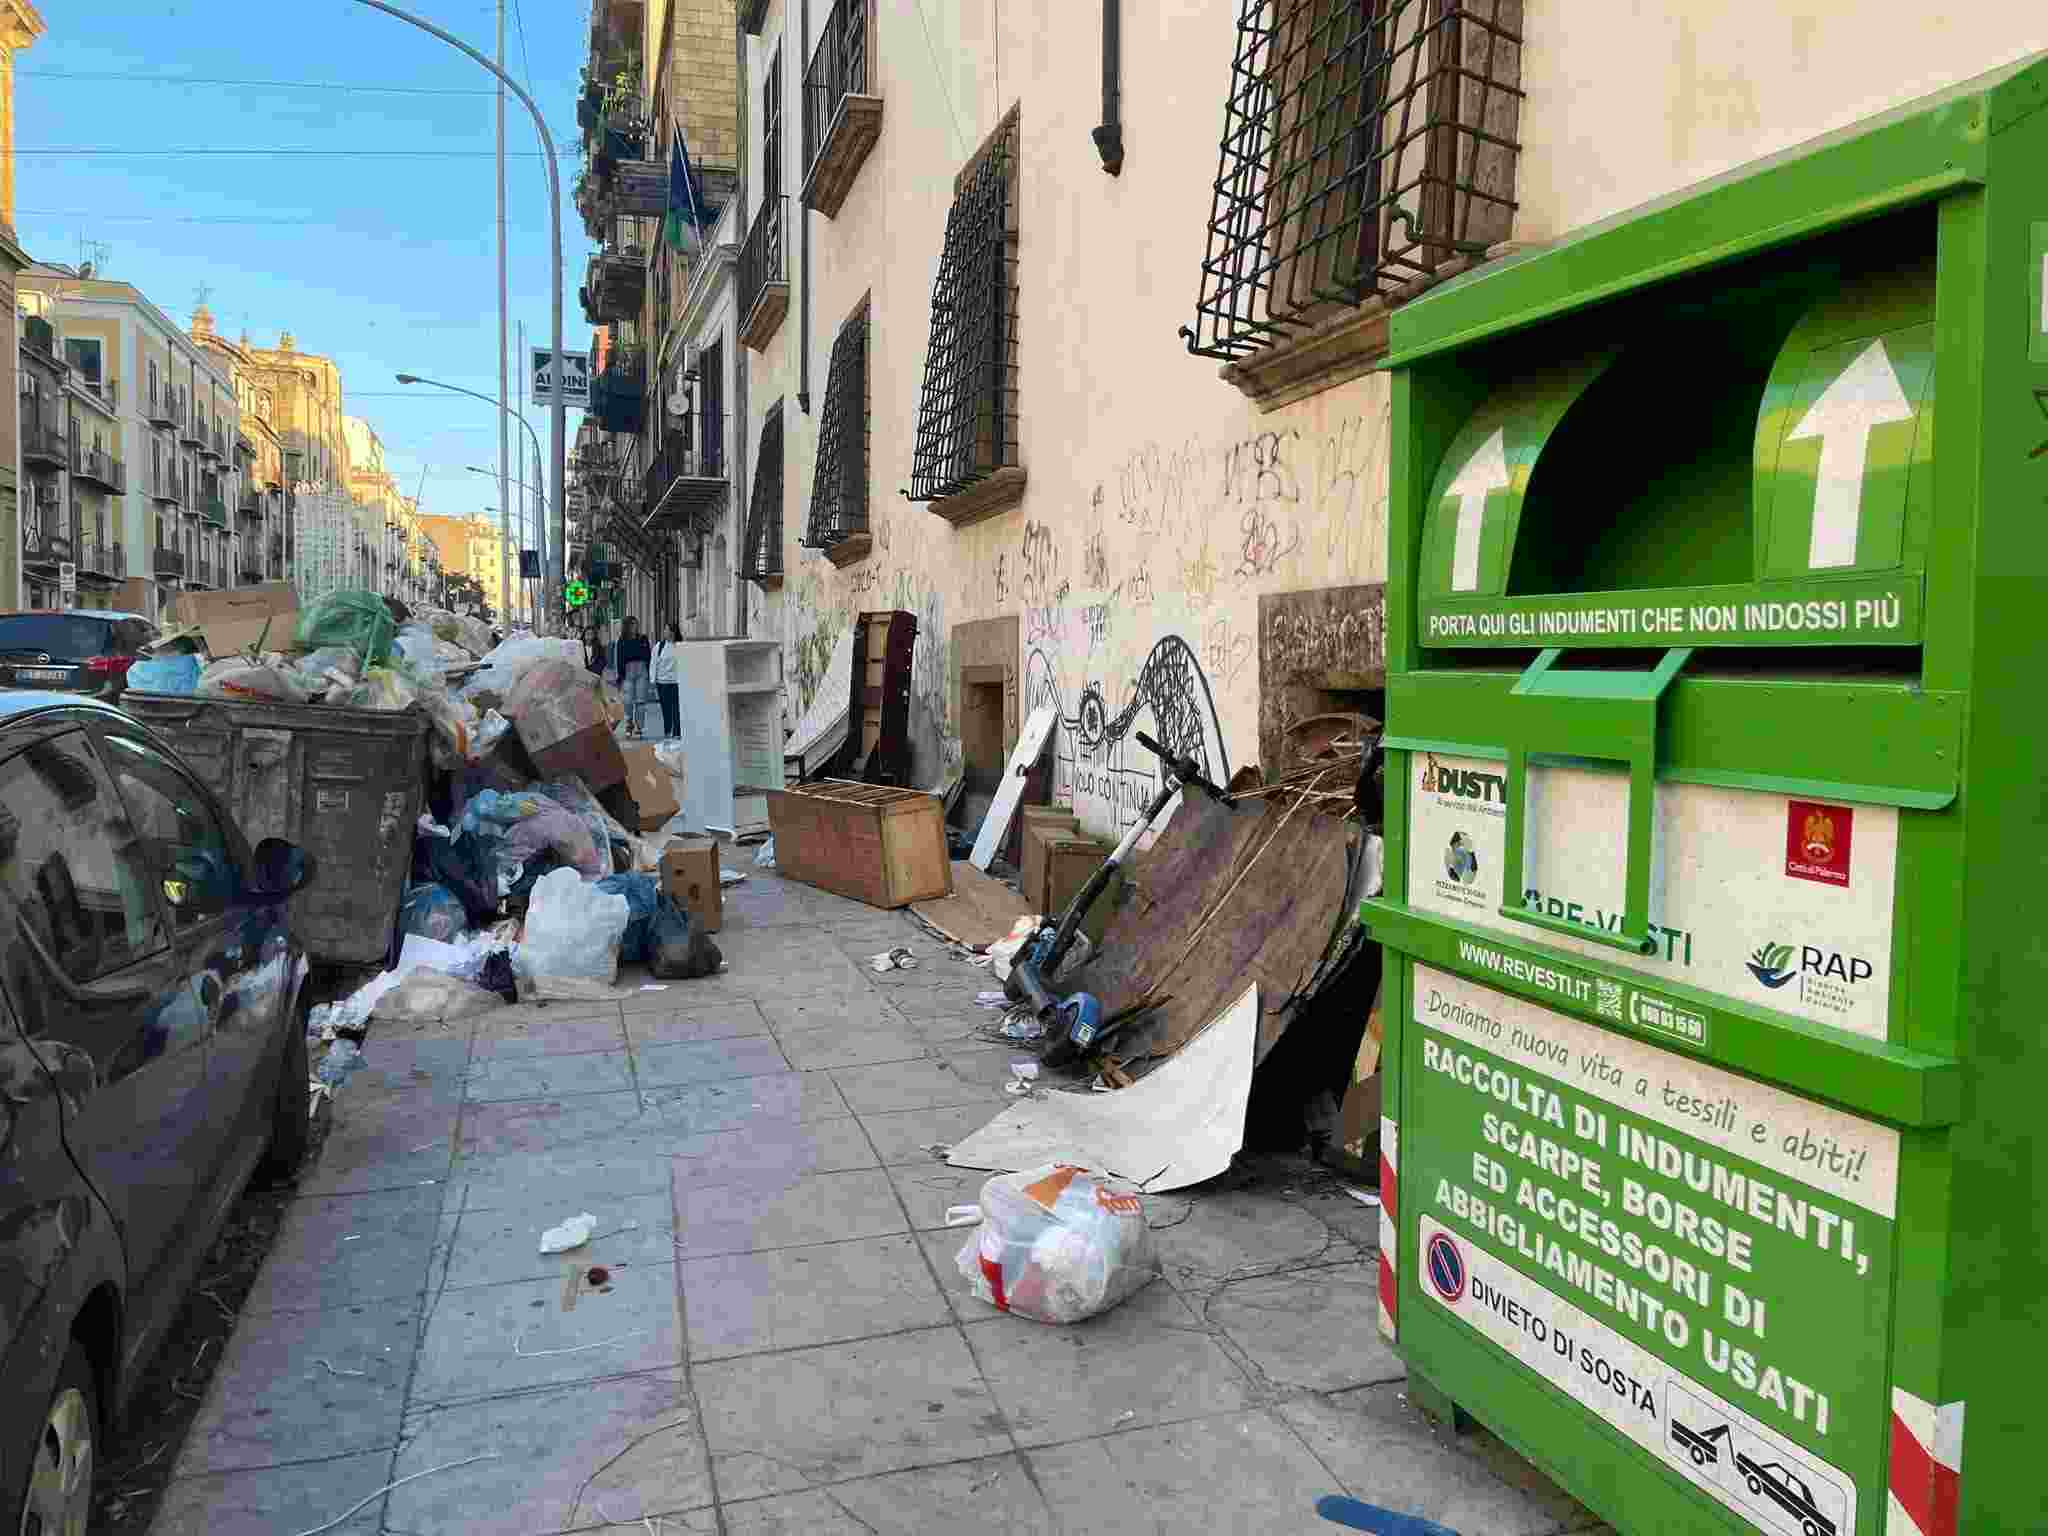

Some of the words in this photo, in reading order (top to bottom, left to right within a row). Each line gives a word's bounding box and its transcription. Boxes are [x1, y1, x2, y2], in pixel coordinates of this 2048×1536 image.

[1429, 615, 1476, 636] PORTA
[1479, 613, 1507, 635] QUI
[1509, 612, 1535, 634] GLI
[1538, 608, 1637, 633] INDUMENTI
[1641, 606, 1684, 633] CHE
[1689, 604, 1738, 631] NON
[1743, 599, 1847, 631] INDOSSI
[1854, 591, 1901, 629] PIÙ
[1459, 941, 1591, 1002] WWW.REVESTI.IT
[1801, 945, 1873, 985] RAP
[1423, 1038, 1566, 1130] RACCOLTA
[1573, 1105, 1608, 1150] DI
[1618, 1124, 1871, 1277] INDUMENTI,
[1424, 989, 1503, 1041] Doniamo
[1511, 1028, 1569, 1069] nuova
[1580, 1048, 1624, 1089] vita
[1634, 1077, 1649, 1098] a
[1662, 1082, 1738, 1136] tessili
[1750, 1121, 1768, 1144] e
[1782, 1129, 1869, 1182] abiti!
[1472, 1151, 1508, 1196] ED
[1515, 1170, 1711, 1308] ACCESSORI
[1722, 1283, 1768, 1338] DI
[1481, 1111, 1611, 1209] SCARPE,
[1622, 1174, 1754, 1274] BORSE
[1434, 1178, 1690, 1348] ABBIGLIAMENTO
[1702, 1327, 1831, 1436] USATI
[1471, 1275, 1548, 1344] DIVIETO
[1553, 1327, 1575, 1362] DI
[1580, 1344, 1659, 1420] SOSTA
